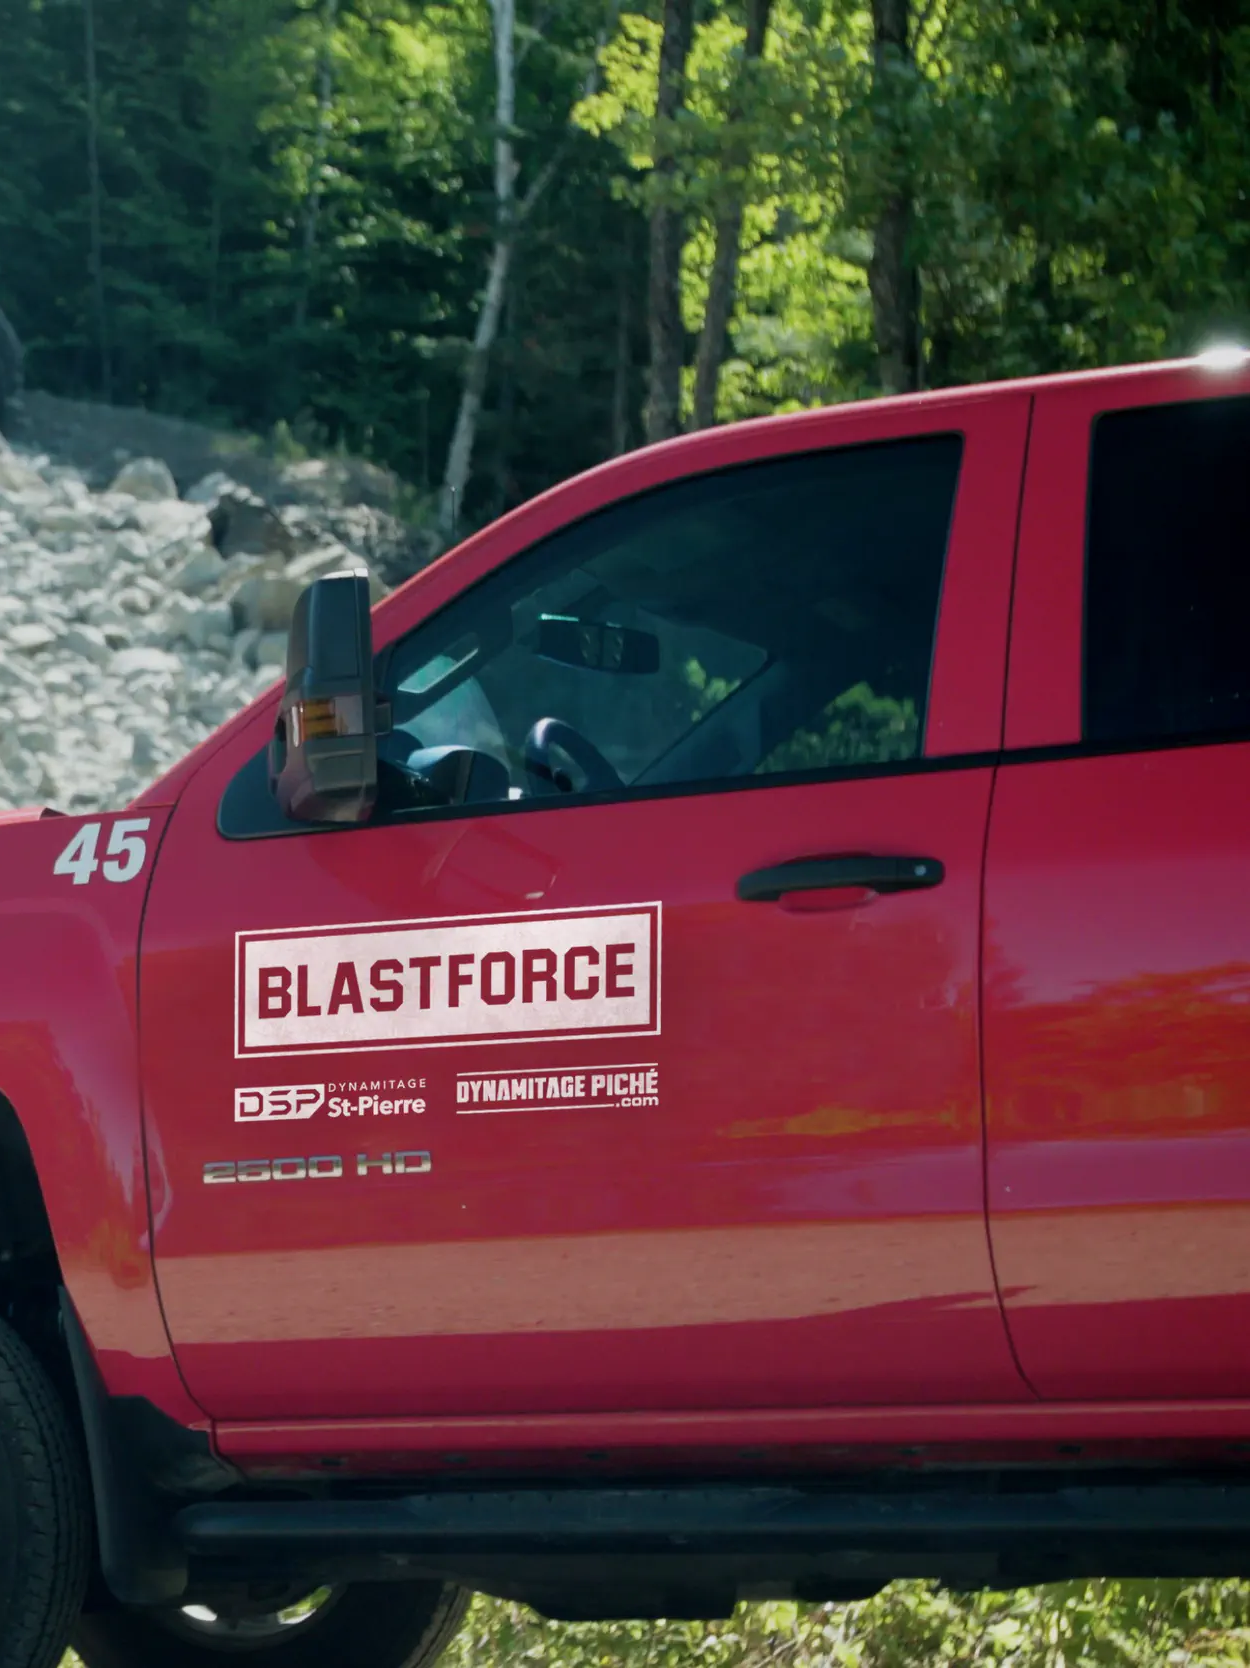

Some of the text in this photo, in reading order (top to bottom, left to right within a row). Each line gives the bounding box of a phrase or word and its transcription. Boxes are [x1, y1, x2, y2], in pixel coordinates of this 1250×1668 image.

[53, 817, 151, 885] 45
[257, 942, 636, 1020] BLASTFORCE
[328, 1078, 427, 1093] DYNAMITAGE
[456, 1068, 659, 1103] DYNAMITAGE PICHÉ
[238, 1088, 322, 1118] DSP
[327, 1094, 427, 1118] St-Pierre
[615, 1096, 660, 1108] .com
[203, 1151, 432, 1184] 2500 HD
